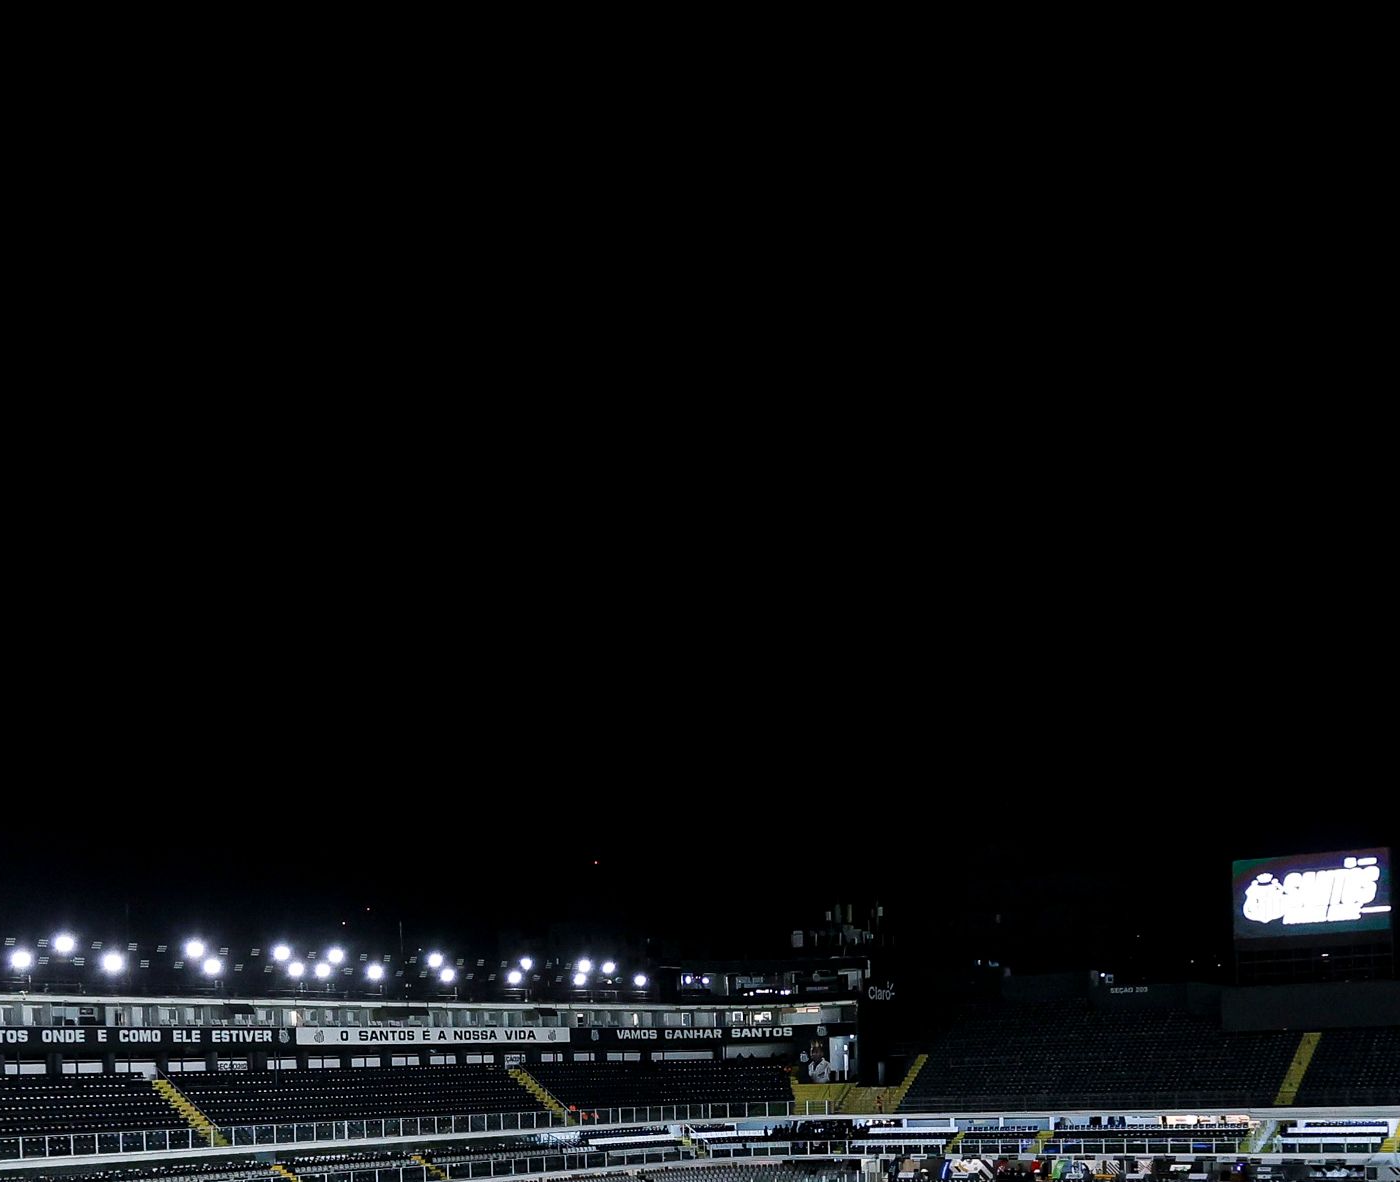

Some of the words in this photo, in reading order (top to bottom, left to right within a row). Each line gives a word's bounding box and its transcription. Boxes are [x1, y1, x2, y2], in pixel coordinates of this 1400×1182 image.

[869, 985, 891, 1000] Claro
[42, 1029, 85, 1043] ONDE
[97, 1030, 107, 1043] E
[119, 1029, 161, 1043] COMO
[173, 1030, 200, 1043] ELE
[211, 1030, 272, 1043] ESTIVER
[340, 1031, 349, 1042] O
[358, 1031, 415, 1042] SANTOS
[437, 1031, 447, 1041] A
[453, 1031, 497, 1041] NOSSA
[504, 1030, 536, 1041] VIDA
[616, 1029, 658, 1040] VAMOS
[664, 1028, 722, 1039] GANHAR
[731, 1027, 793, 1037] SANTOS
